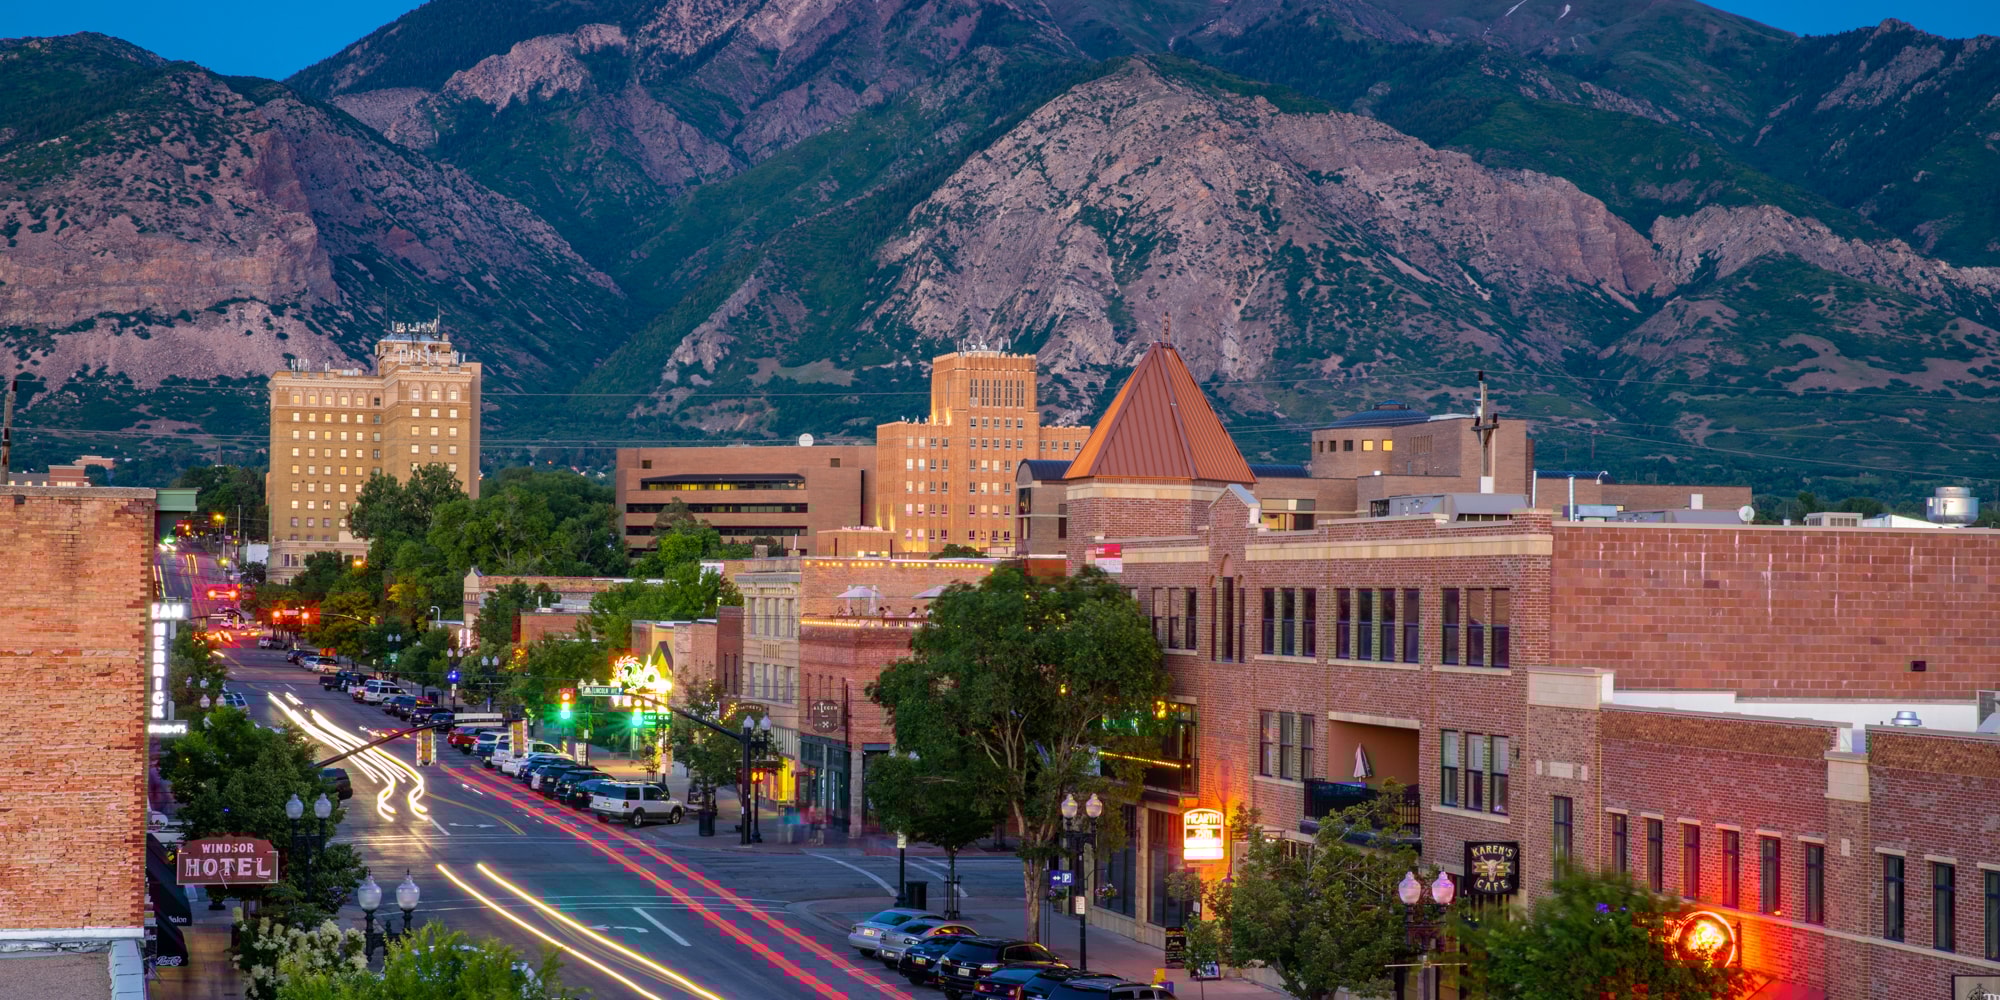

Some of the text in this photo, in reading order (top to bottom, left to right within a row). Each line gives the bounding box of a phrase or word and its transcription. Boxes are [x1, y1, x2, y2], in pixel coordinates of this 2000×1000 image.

[1184, 812, 1221, 824] HEARTH
[201, 843, 255, 854] WINDSOR
[1471, 845, 1513, 857] KAREN'S
[184, 857, 271, 877] HOTEL
[1477, 879, 1508, 891] CAFE
